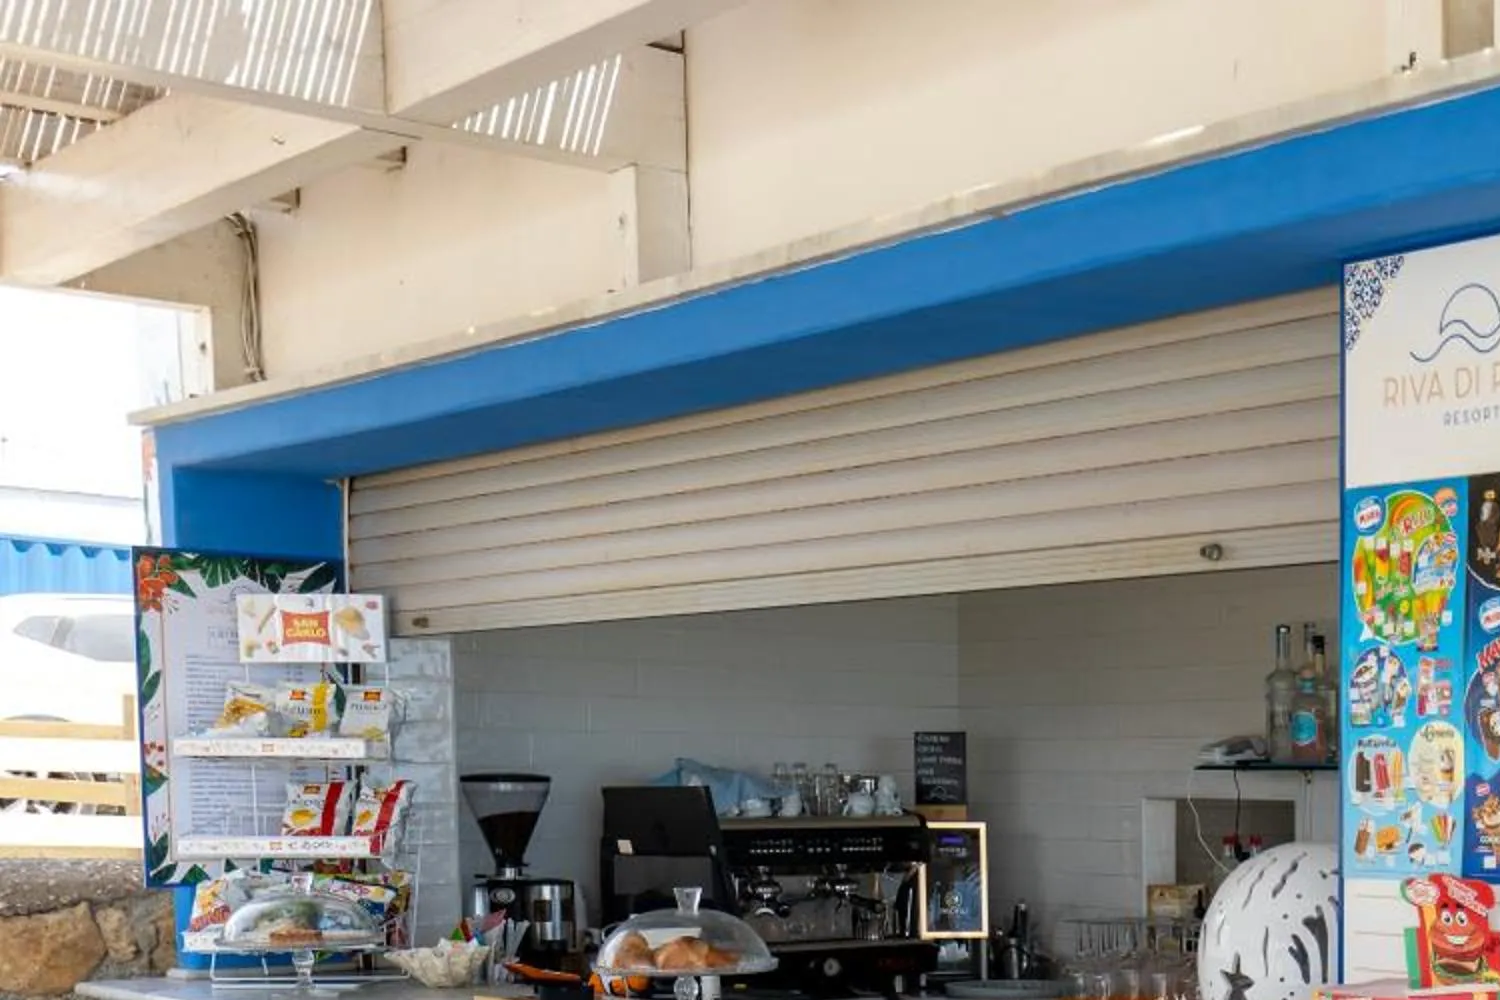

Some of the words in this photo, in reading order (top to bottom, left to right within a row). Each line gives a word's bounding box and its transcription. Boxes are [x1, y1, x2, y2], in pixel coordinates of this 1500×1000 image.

[1382, 373, 1444, 408] RIVA
[1455, 363, 1480, 399] DI
[1444, 405, 1500, 427] RESORT
